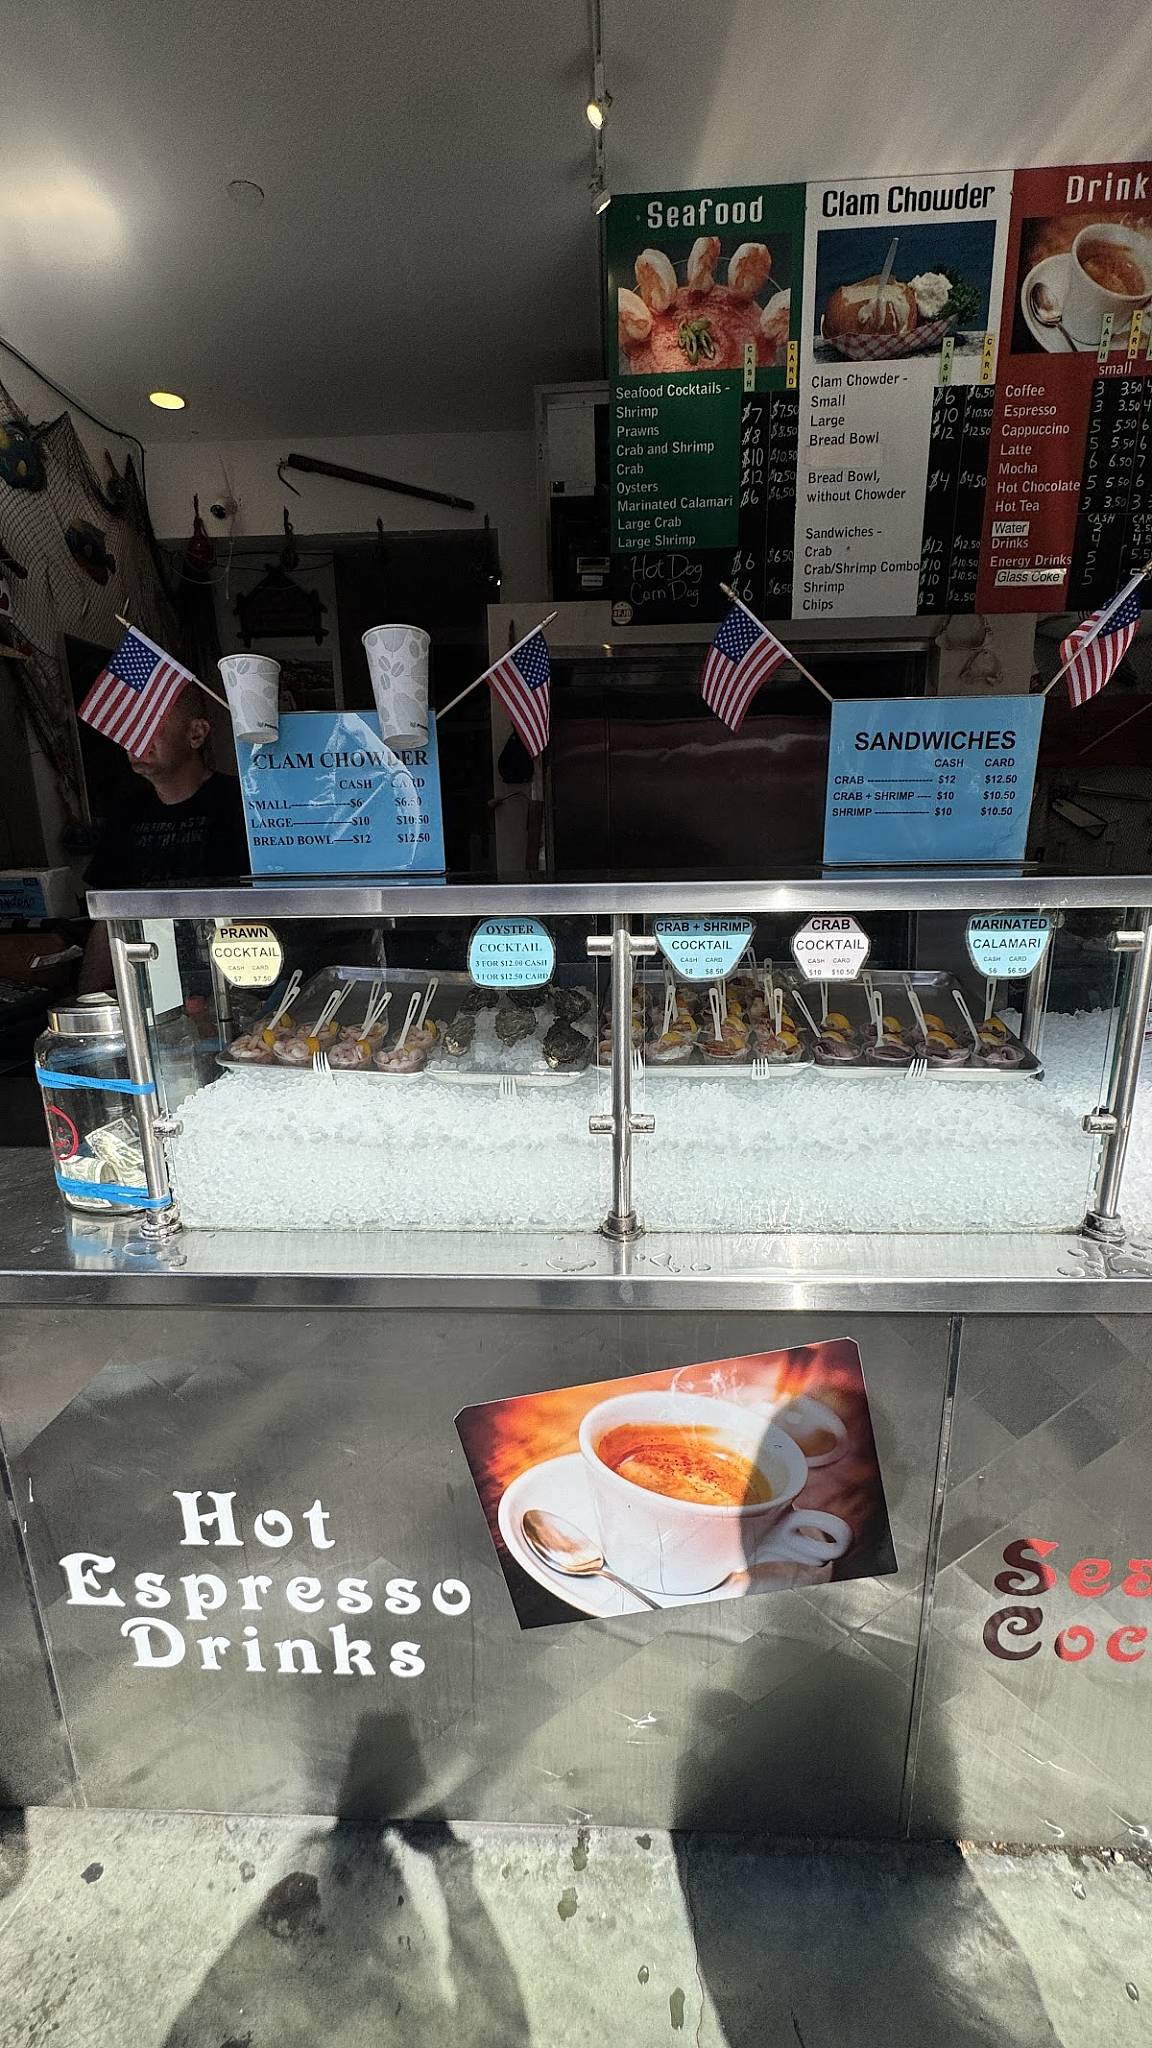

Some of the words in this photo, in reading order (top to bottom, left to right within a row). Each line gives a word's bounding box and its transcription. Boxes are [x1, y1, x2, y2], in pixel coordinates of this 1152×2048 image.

[1066, 172, 1148, 204] Drink
[822, 190, 880, 218] Clam
[887, 184, 995, 214] Chowder
[648, 196, 763, 229] Seafood
[983, 337, 993, 381] CARD
[1099, 362, 1132, 375] small
[811, 375, 842, 388] Clam
[846, 373, 899, 386] Chowder
[616, 386, 664, 400] Seafood
[667, 382, 721, 397] Cocktails
[811, 394, 845, 407] Small
[934, 387, 955, 407] $6
[1005, 385, 1045, 397] Coffee
[1094, 382, 1105, 397] 3
[616, 406, 658, 419] Shrimp
[742, 402, 762, 423] $7
[1004, 405, 1057, 417] Espresso
[1093, 400, 1103, 413] 3
[810, 415, 845, 427] Large
[933, 408, 958, 424] $10
[617, 424, 659, 437] Prawns
[742, 429, 761, 445] $8
[809, 434, 846, 446] Bread
[850, 432, 879, 444] Bowl
[932, 424, 954, 439] $12
[1001, 424, 1070, 439] Cappuccino
[1089, 419, 1101, 434] 5
[1141, 417, 1149, 431] 6
[1000, 444, 1032, 456] Latte
[1089, 437, 1099, 449] 5
[1140, 435, 1147, 450] 6
[616, 444, 643, 456] Crab
[648, 443, 668, 454] and
[672, 441, 714, 454] Shrimp
[742, 448, 763, 468] $10
[999, 462, 1038, 474] Mocha
[1089, 451, 1097, 469] 6
[1137, 454, 1146, 469] 7
[616, 463, 643, 475] Crab
[741, 469, 763, 486] $12
[808, 472, 843, 484] Bread
[848, 470, 880, 483] Bowl,
[616, 482, 658, 494] Oysters
[997, 482, 1017, 494] Hot
[1022, 480, 1081, 492] Chocolate
[1086, 475, 1098, 490] 5
[1135, 473, 1144, 487] 6
[617, 498, 676, 512] Marinated
[680, 496, 733, 509] Calamari
[740, 489, 758, 508] $6
[807, 489, 851, 503] without
[854, 488, 905, 500] Chowder
[995, 501, 1015, 512] Hot
[1020, 499, 1040, 511] Tea
[1082, 496, 1092, 510] 3
[1132, 494, 1141, 511] 3
[618, 518, 650, 530] Large
[654, 516, 681, 528] Crab
[1088, 514, 1115, 525] CASH
[806, 526, 873, 540] Sandwiches
[994, 523, 1027, 535] Water
[618, 536, 650, 548] Large
[655, 534, 696, 547] Shrimp
[805, 546, 832, 557] Crab
[922, 536, 943, 553] $12
[991, 537, 1029, 549] Drinks
[1092, 532, 1100, 548] 4
[990, 556, 1031, 568] Energy
[1035, 554, 1072, 567] Drinks
[1086, 551, 1097, 566] 5
[631, 555, 664, 581] Hot
[667, 554, 703, 582] Dog
[804, 562, 876, 575] Crab/Shrimp
[881, 561, 920, 572] Combo
[997, 571, 1029, 583] Glass
[1031, 571, 1060, 582] Coke
[1082, 568, 1094, 586] 5
[631, 583, 666, 605] Corn
[670, 580, 699, 607] Dog
[804, 582, 845, 594] Shrimp
[803, 599, 833, 611] Chips
[854, 731, 1016, 750] SANDWICHES
[253, 753, 314, 769] CLAM
[320, 750, 428, 768] CHOWDER
[935, 758, 964, 768] CASH
[985, 758, 1015, 767] CARD
[339, 779, 372, 789] CASH
[835, 776, 864, 785] CRAB
[938, 775, 956, 785] $12
[985, 774, 1017, 785] $12.50
[833, 792, 862, 801] CRAB
[875, 791, 914, 800] SHRIMP
[937, 791, 954, 801] $10
[983, 791, 1015, 800] $10.50
[249, 801, 291, 810] SMALL
[832, 807, 872, 816] SHRIMP
[935, 807, 952, 816] $10
[981, 807, 1012, 816] $10.50
[251, 818, 294, 828] LARGE
[351, 816, 369, 826] $10
[253, 836, 294, 846] BREAD
[298, 835, 334, 845] BOWL
[353, 834, 371, 844] $12
[486, 925, 534, 934] OYSTER
[656, 922, 689, 931] CRAB
[704, 922, 750, 931] SHRIMP
[812, 919, 850, 930] CRAB
[971, 919, 1047, 929] MARINATED
[221, 928, 268, 938] PRAWN
[480, 943, 542, 952] COCKTAIL
[672, 941, 732, 949] COCKTAIL
[796, 939, 864, 950] COCKTAIL
[973, 938, 1040, 948] CALAMARI
[215, 947, 279, 957] COCKTAIL
[172, 1490, 336, 1549] Hot
[59, 1552, 471, 1620] Espresso
[983, 1605, 1147, 1663] Coc
[120, 1617, 426, 1677] Drinks
